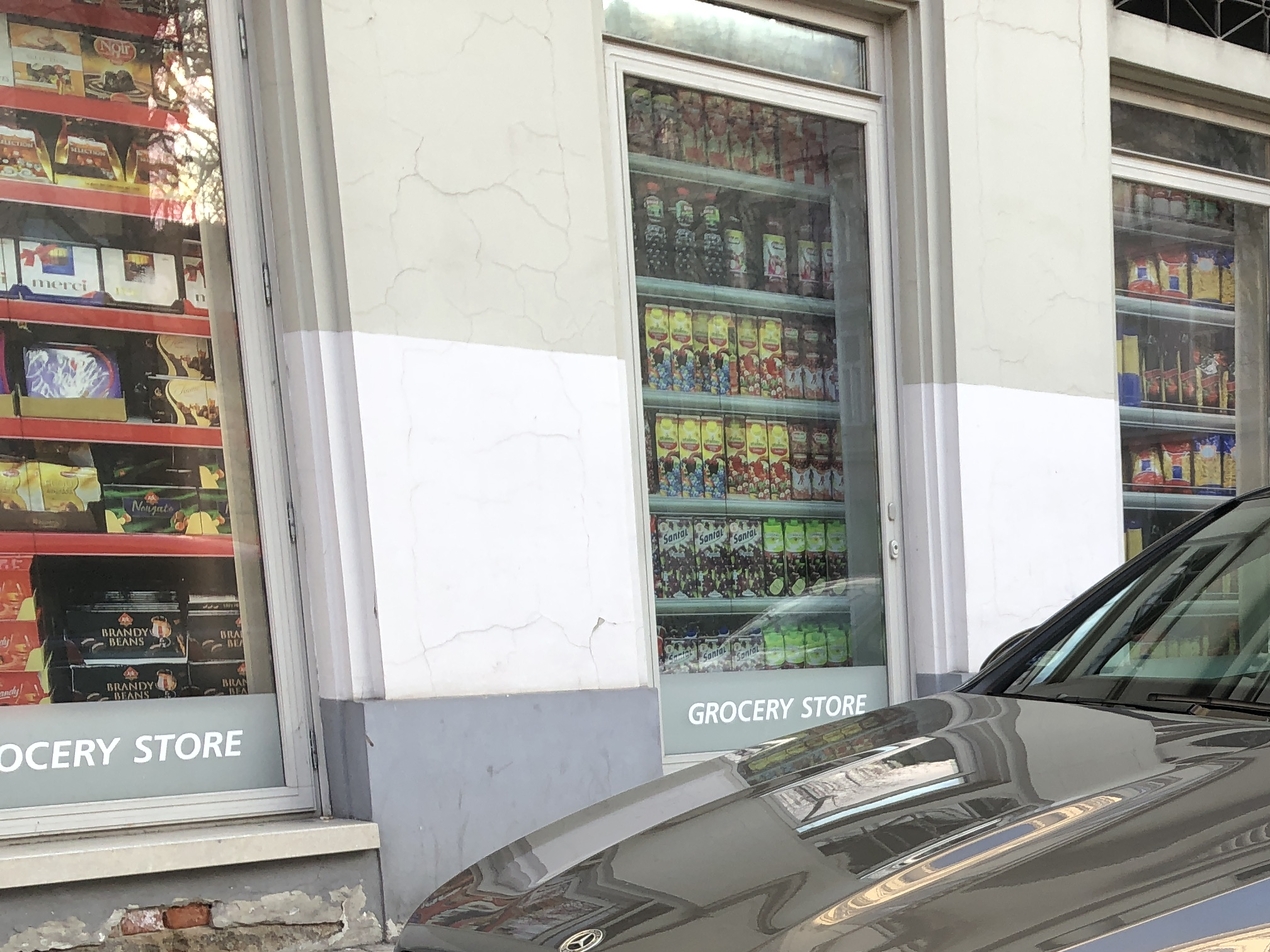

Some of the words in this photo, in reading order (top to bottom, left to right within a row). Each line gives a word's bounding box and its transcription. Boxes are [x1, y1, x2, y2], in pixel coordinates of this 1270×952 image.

[100, 39, 131, 58] Noir
[32, 279, 87, 292] merci
[102, 628, 150, 638] BRANDY
[109, 637, 145, 647] BEANS
[107, 681, 154, 692] BRANDY
[114, 691, 150, 700] BEANS
[688, 697, 795, 725] GROCERY
[801, 694, 868, 719] STORE
[133, 729, 244, 764] STORE
